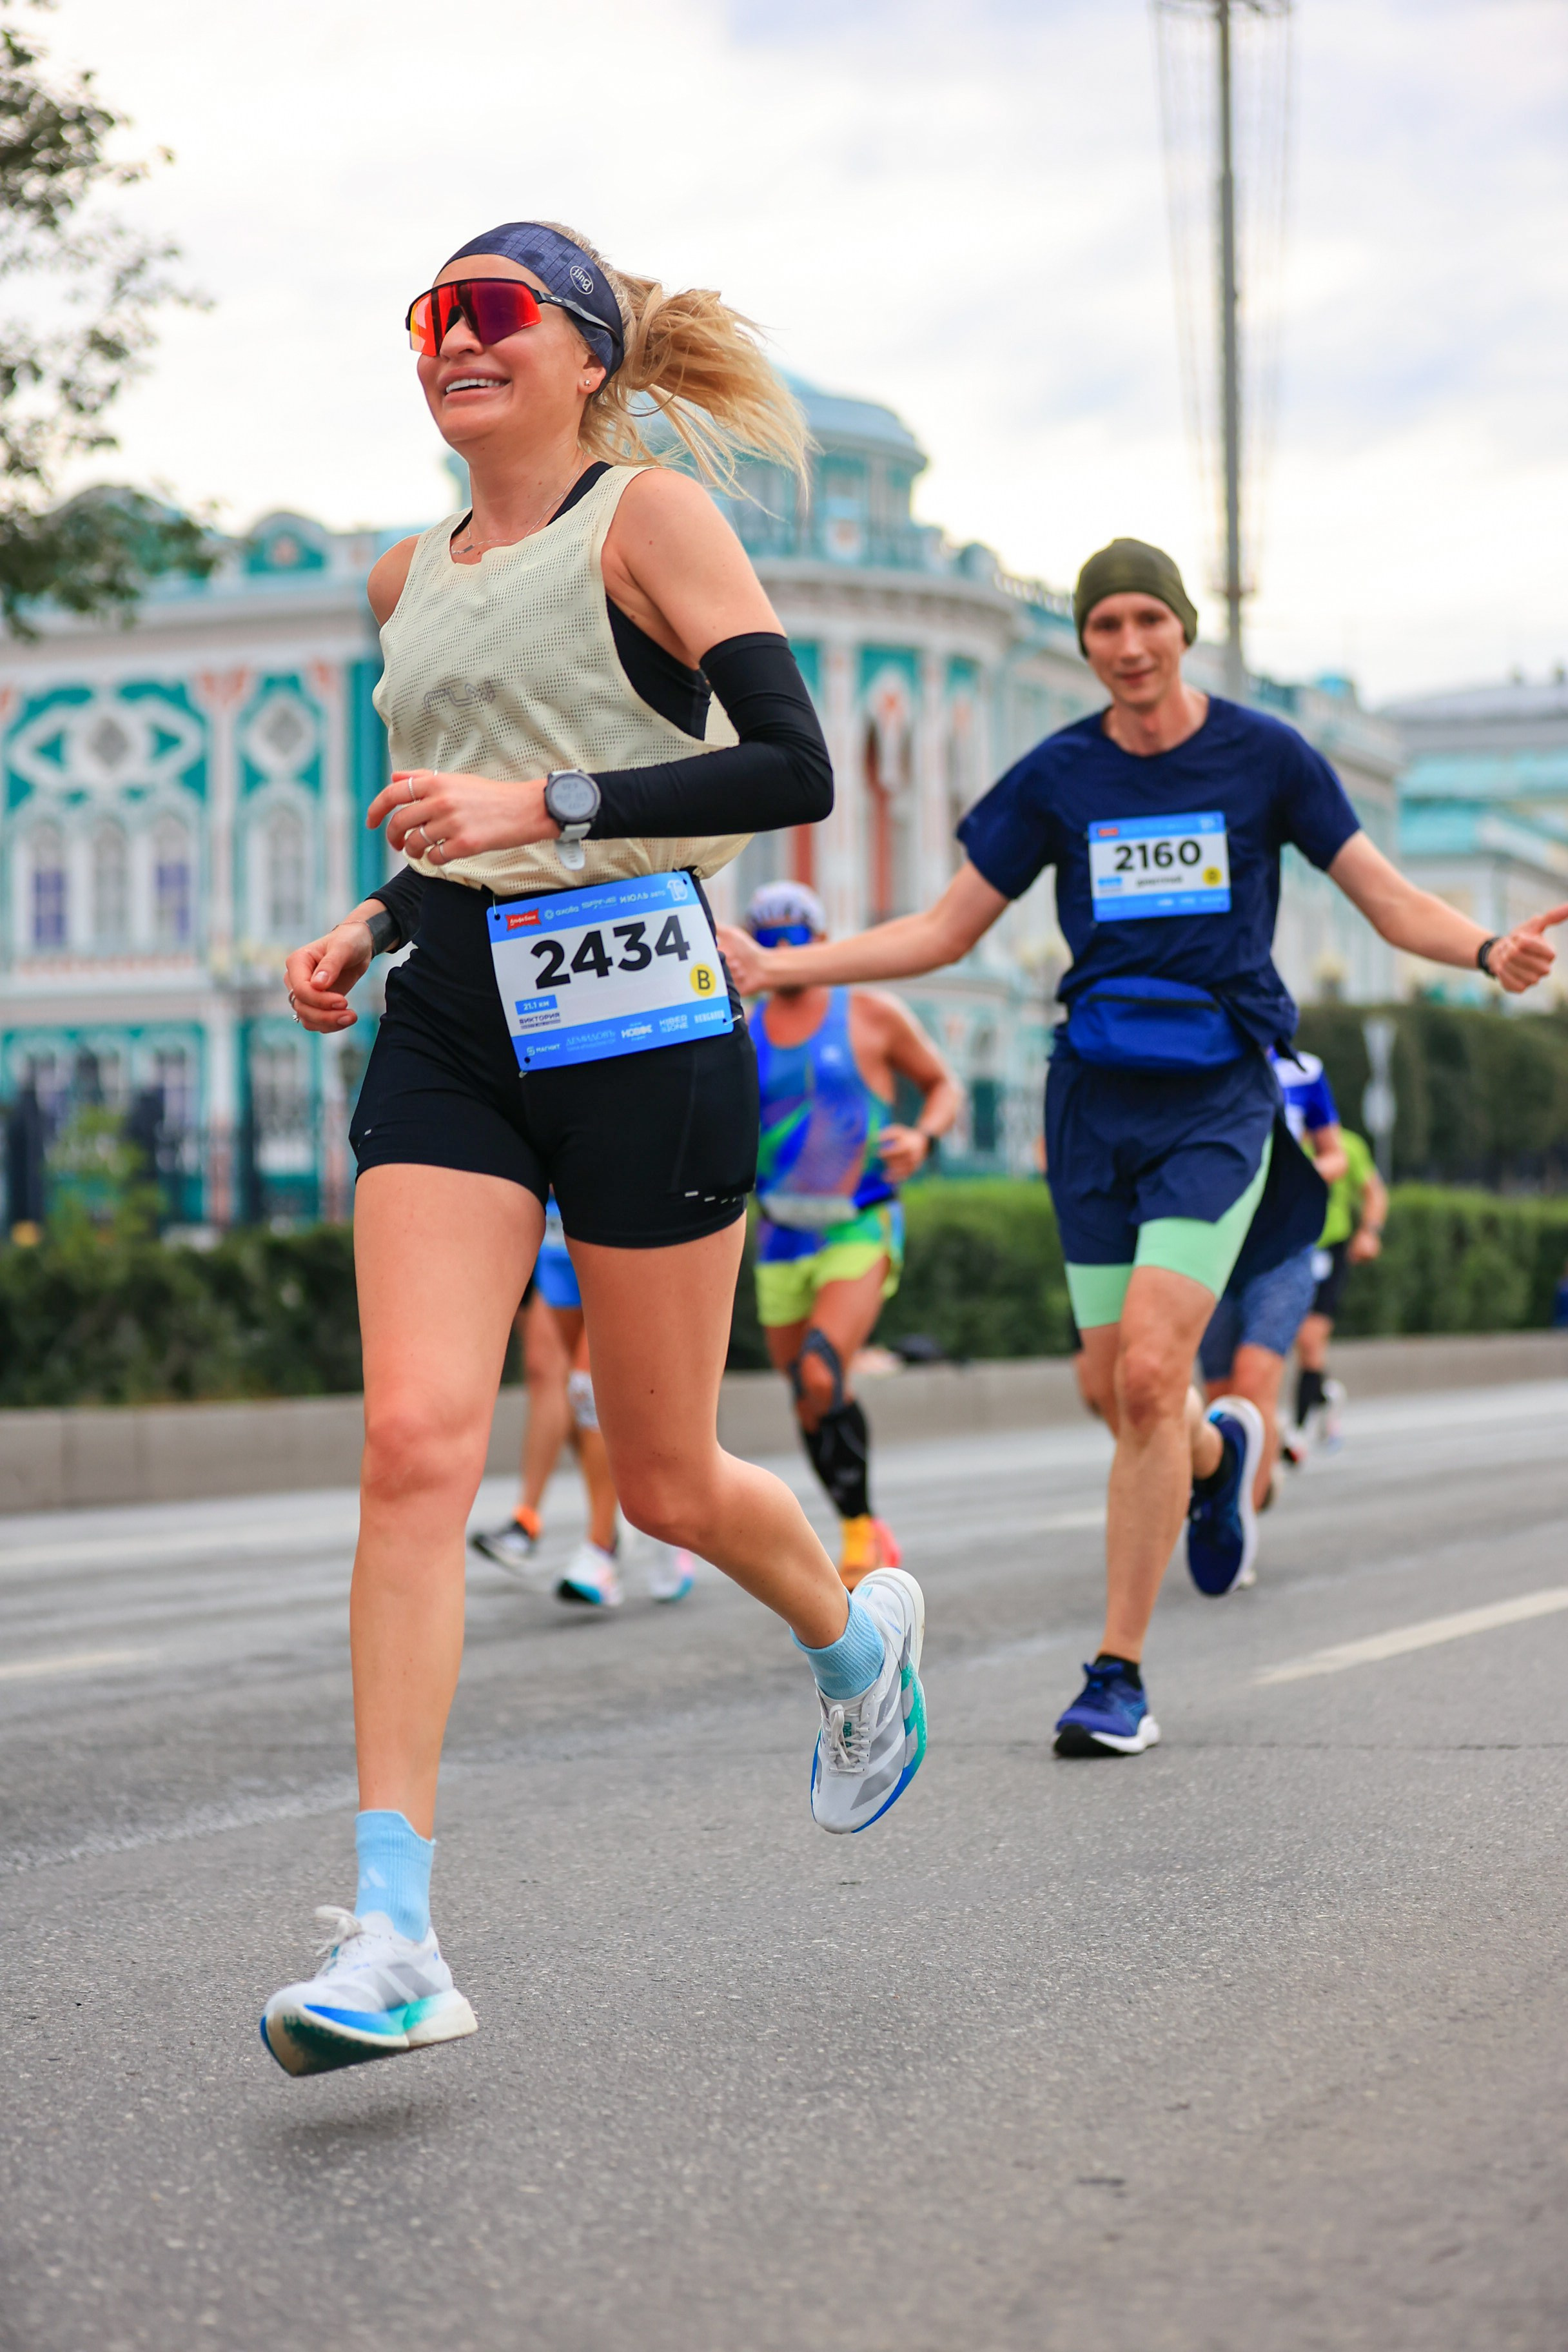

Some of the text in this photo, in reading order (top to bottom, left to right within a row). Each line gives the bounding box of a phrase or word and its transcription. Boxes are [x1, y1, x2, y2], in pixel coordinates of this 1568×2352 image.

[572, 268, 592, 291] Buff
[1115, 840, 1201, 871] 2160
[530, 915, 691, 990] 2434
[698, 970, 710, 990] B
[519, 1012, 560, 1025] ВИКТОРИЯ
